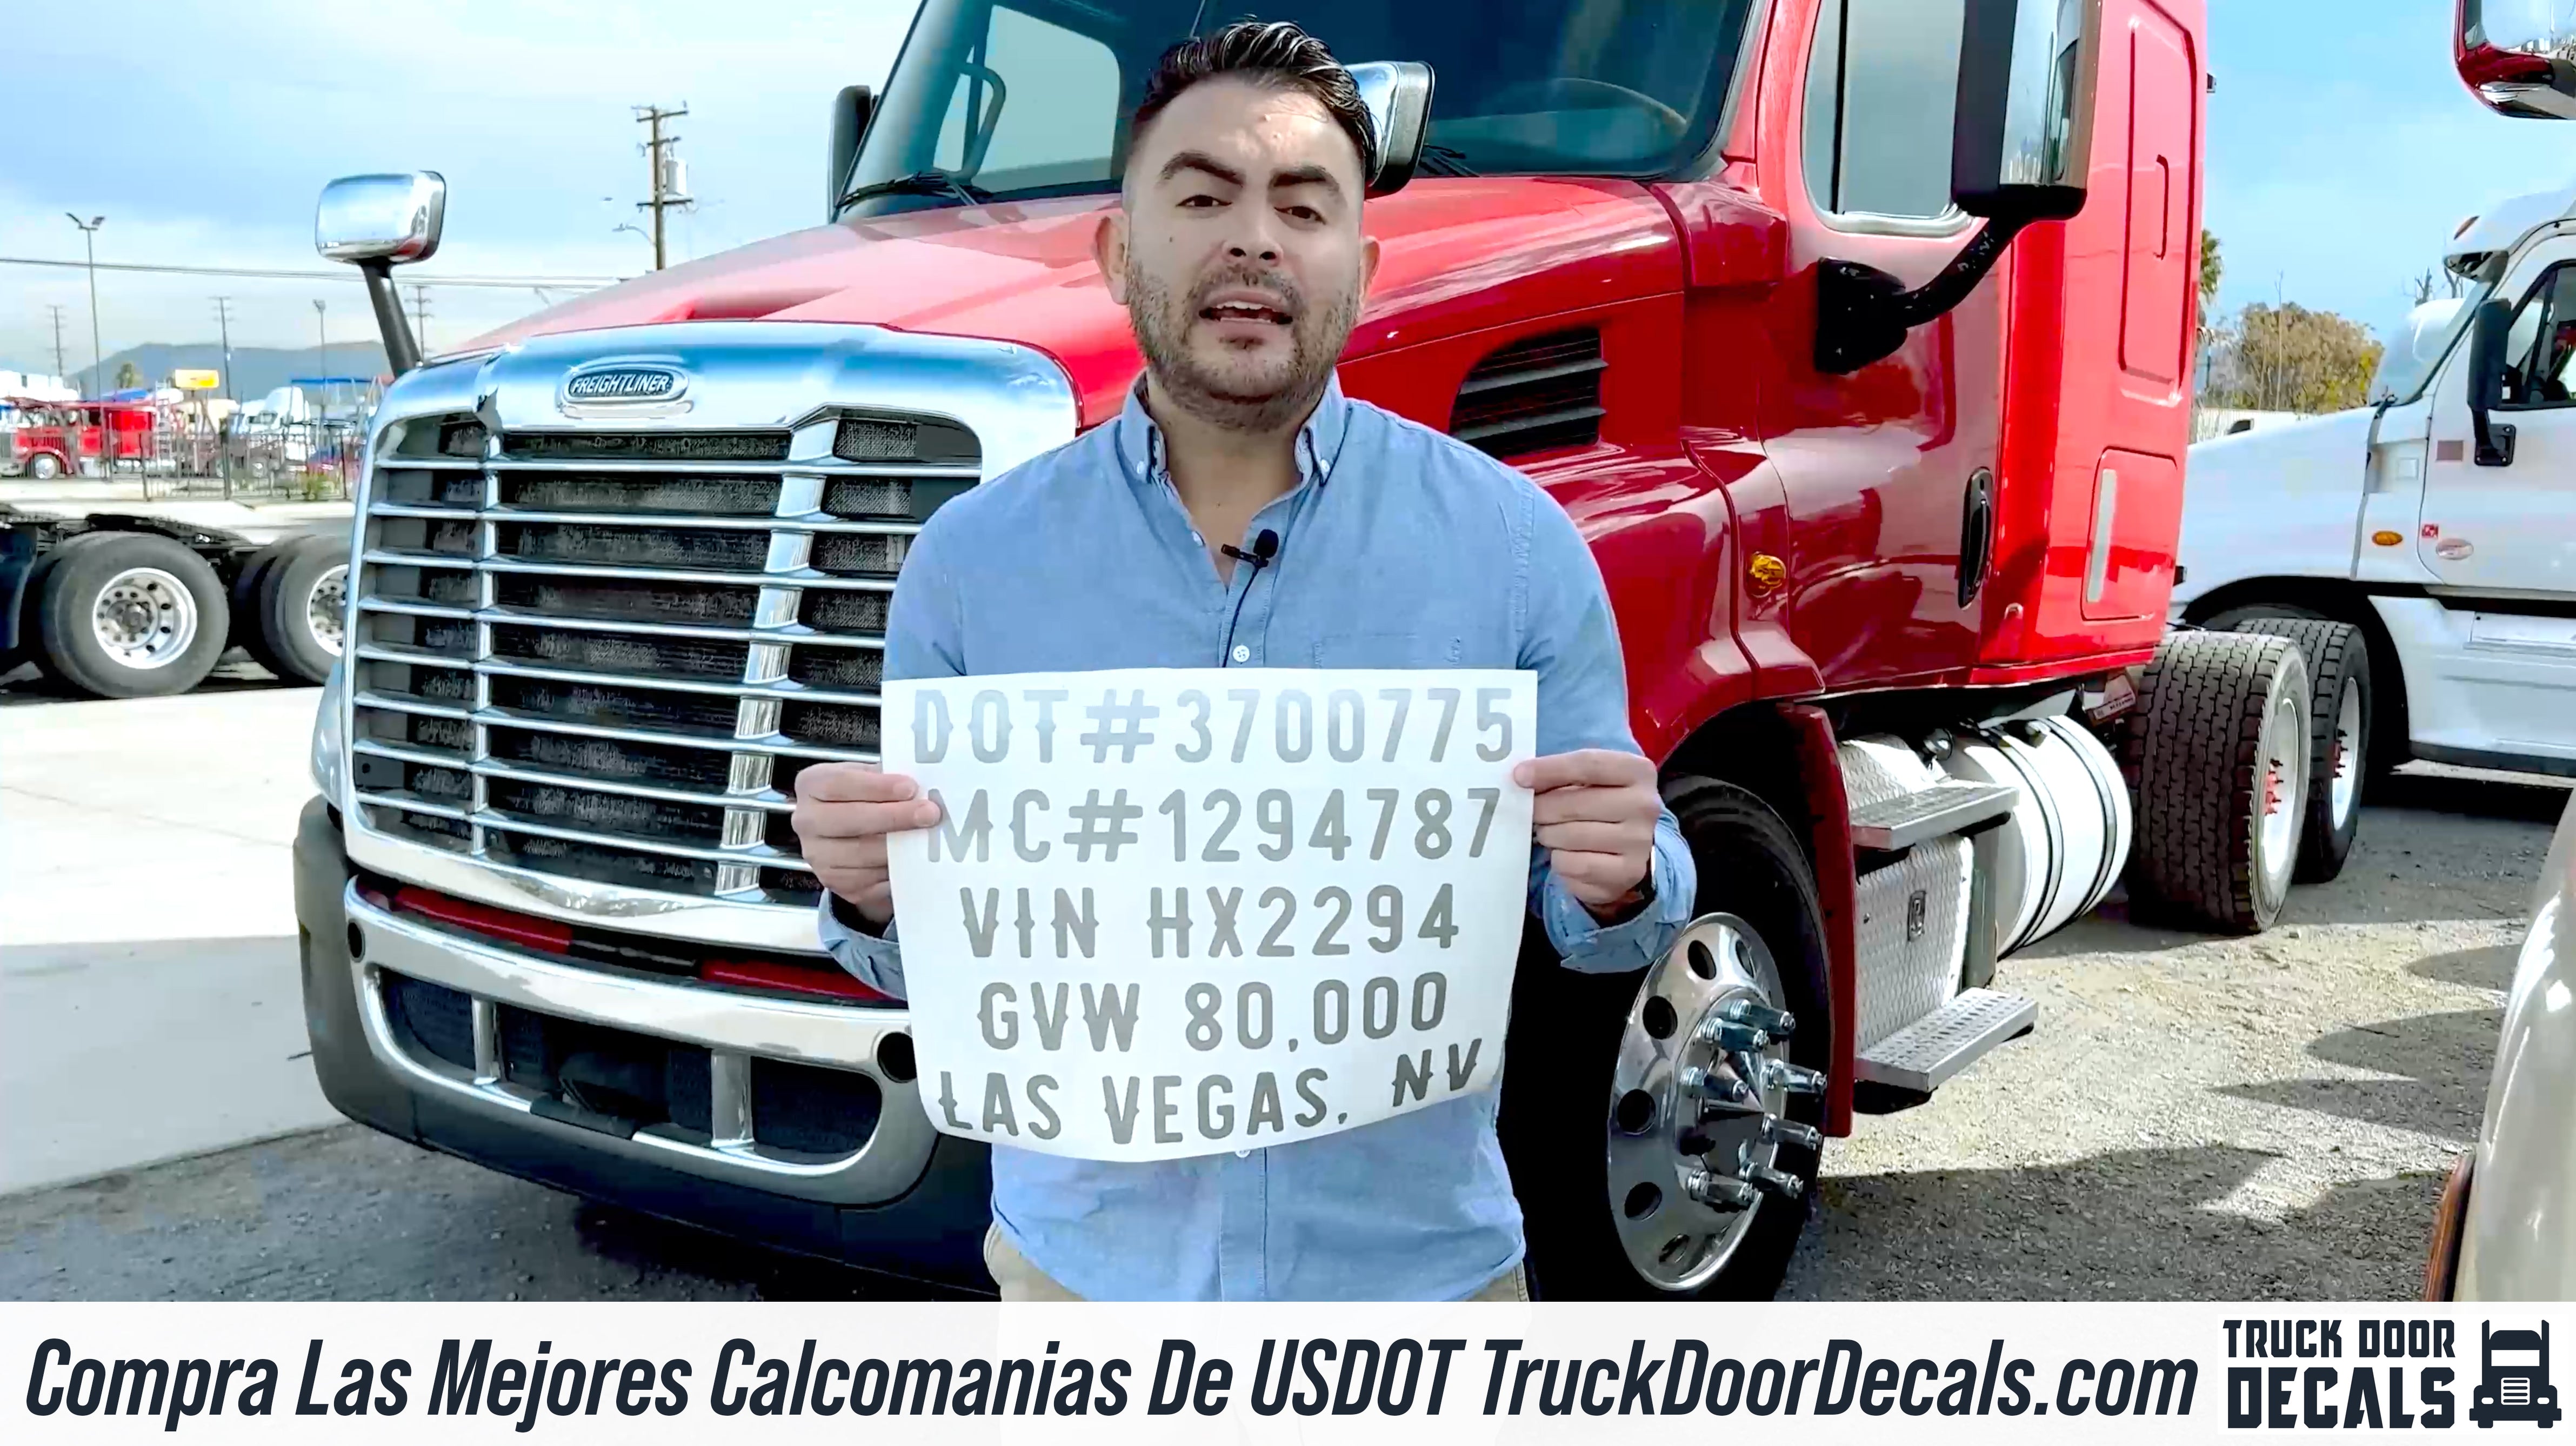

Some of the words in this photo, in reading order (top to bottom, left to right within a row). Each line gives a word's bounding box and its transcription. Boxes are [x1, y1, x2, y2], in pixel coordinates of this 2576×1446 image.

[572, 374, 670, 393] FREIGHTLINER
[910, 689, 1513, 764] DOT#3700775
[928, 788, 1500, 862] MC#1294787
[960, 887, 1099, 959] VIN
[1146, 883, 1459, 959] HX2294
[977, 982, 1140, 1053] GVW
[938, 1071, 1062, 1140] LAS
[1392, 1037, 1483, 1107] NV
